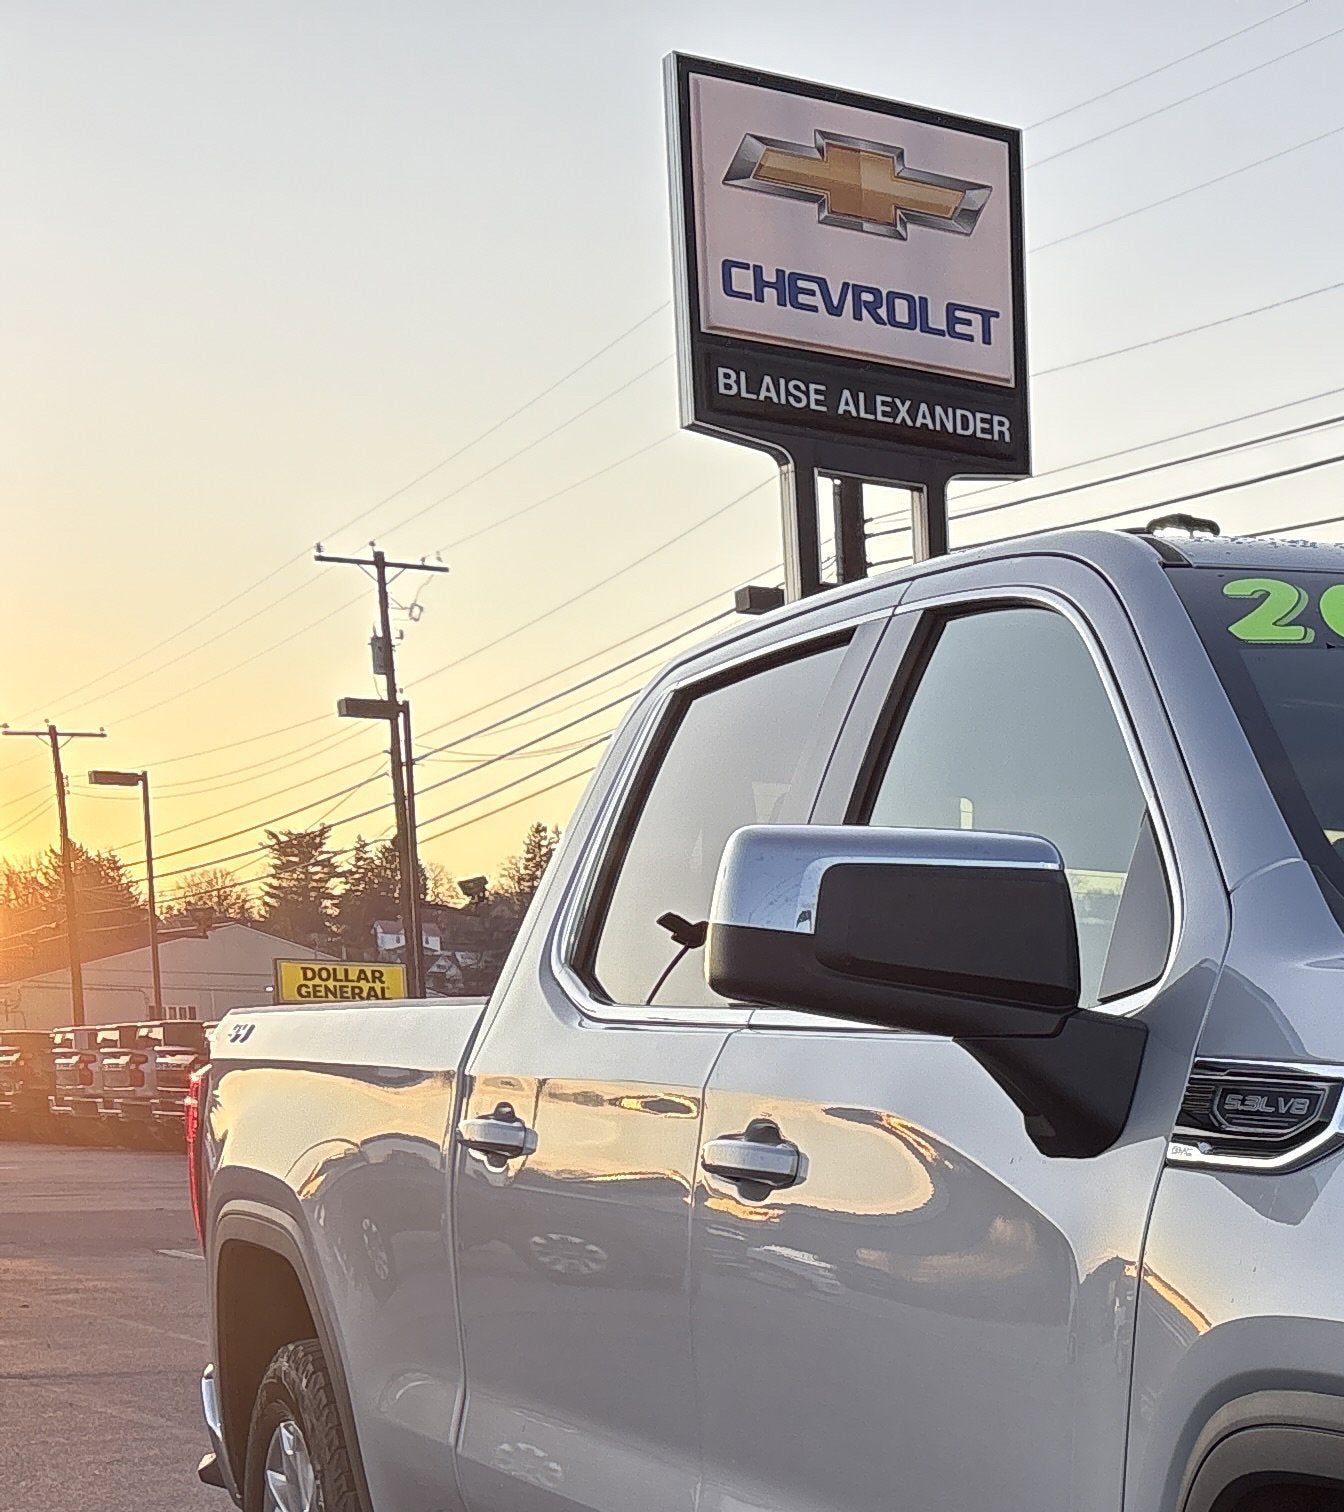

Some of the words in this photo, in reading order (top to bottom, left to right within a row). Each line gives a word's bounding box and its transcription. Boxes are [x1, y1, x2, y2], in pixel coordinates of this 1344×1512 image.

[721, 258, 1000, 345] CHEVROLET
[717, 366, 828, 412] BLAISE
[837, 388, 1011, 443] ALEXANDER
[296, 983, 392, 1001] GENERAL
[300, 966, 386, 984] DOLLAR
